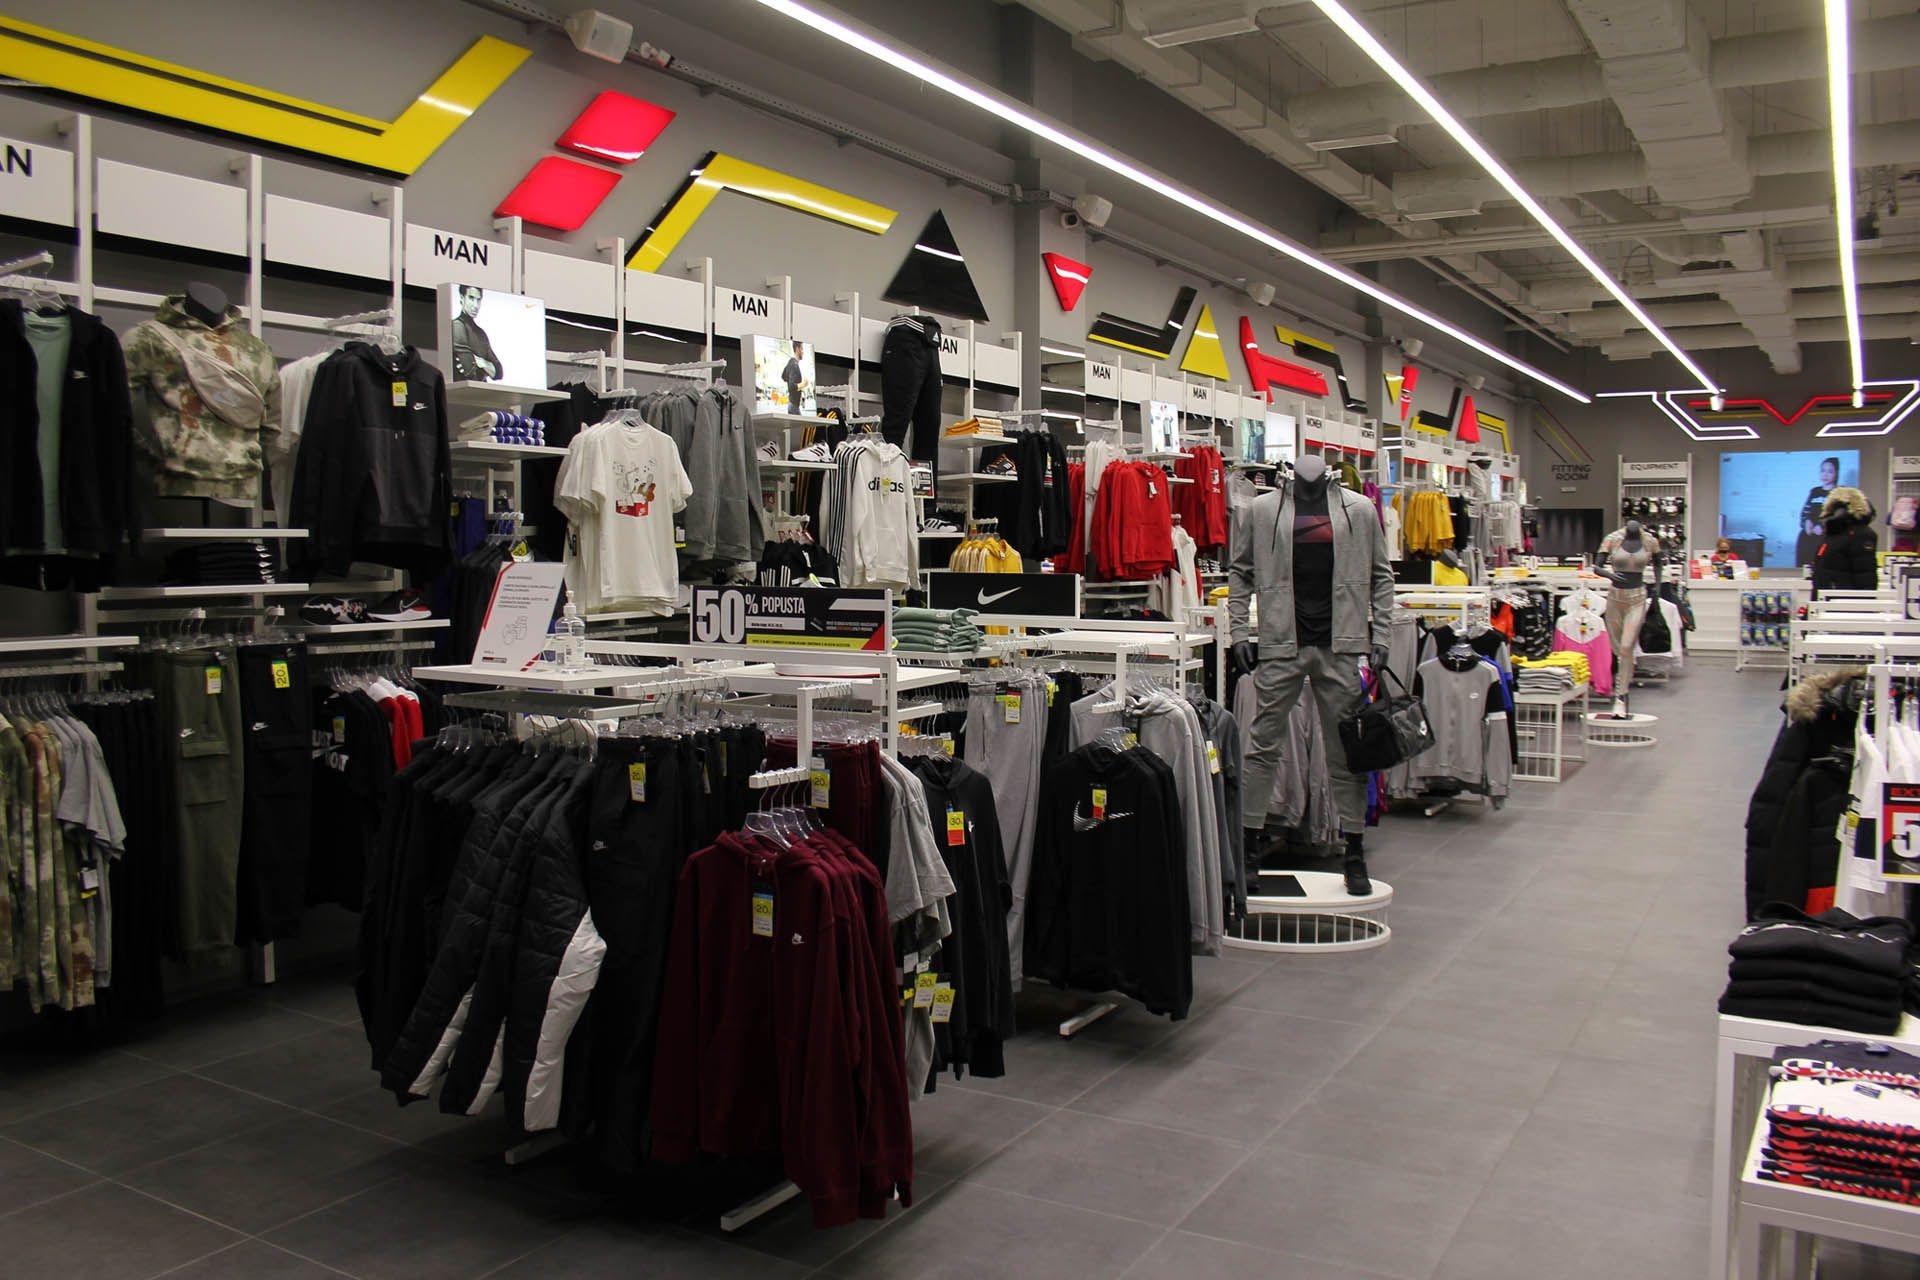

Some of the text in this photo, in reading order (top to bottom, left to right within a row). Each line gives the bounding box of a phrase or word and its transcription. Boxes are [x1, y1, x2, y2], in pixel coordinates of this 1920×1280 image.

[434, 234, 488, 266] MAN
[732, 294, 768, 318] MAN
[1092, 364, 1111, 380] MAN
[1193, 387, 1207, 400] MAN
[1552, 464, 1592, 473] FITTING
[1630, 462, 1679, 471] EQUIPMENT
[868, 477, 904, 493] dias
[1556, 473, 1589, 481] ROOM
[762, 597, 806, 614] POPUSTA
